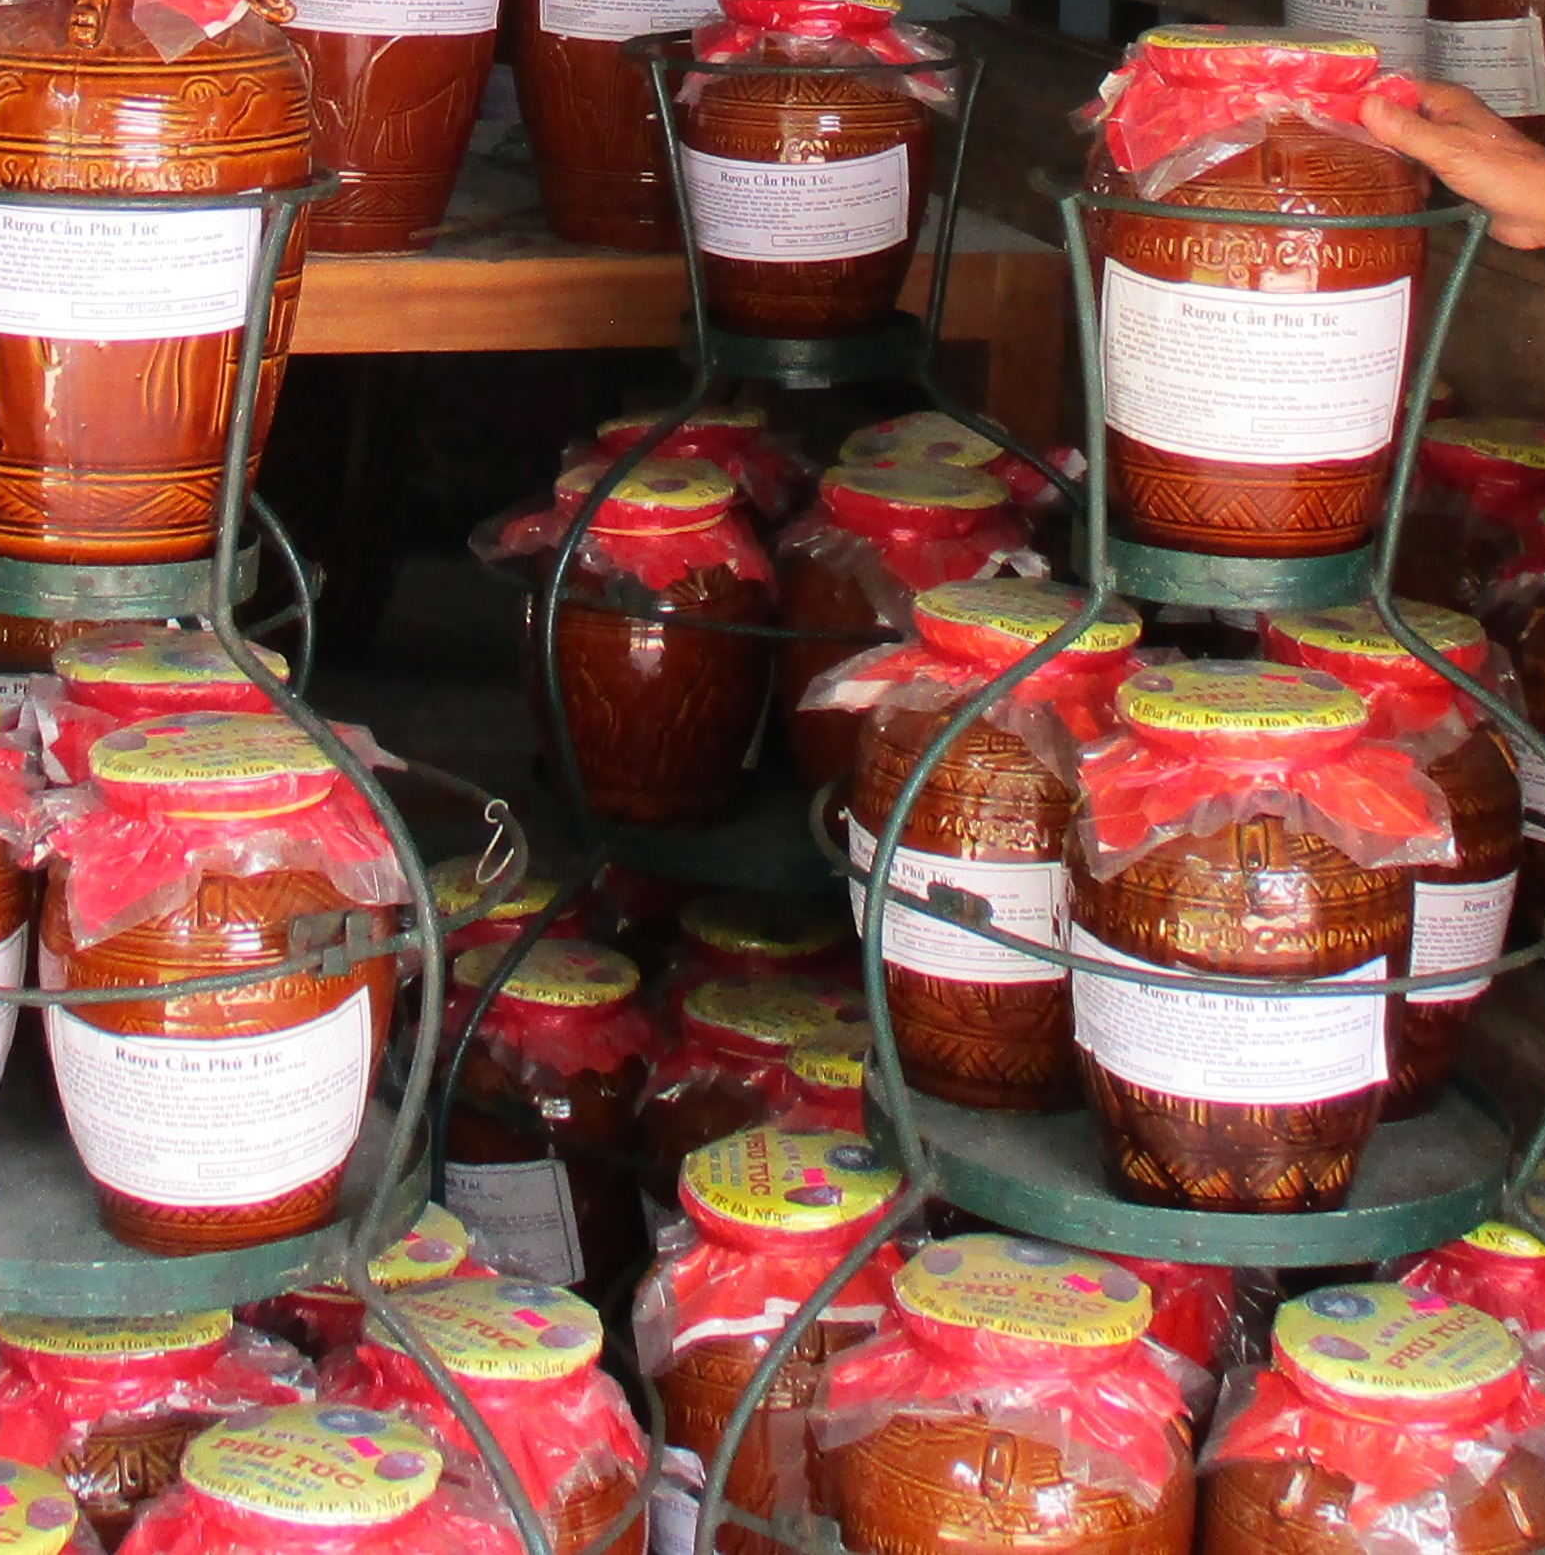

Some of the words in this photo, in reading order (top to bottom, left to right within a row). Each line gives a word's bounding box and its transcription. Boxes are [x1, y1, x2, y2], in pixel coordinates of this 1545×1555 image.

[720, 171, 750, 187] Rượu
[754, 171, 777, 187] Cần
[782, 174, 806, 187] Phú
[812, 174, 834, 186] Túc
[2, 215, 44, 236] Rượu
[50, 215, 83, 236] Cần
[90, 221, 122, 237] Phú
[130, 221, 159, 236] Túc
[1181, 303, 1226, 327] Rượu
[1233, 307, 1265, 326] Cần
[1273, 311, 1304, 328] Phú
[1310, 310, 1340, 328] Túc
[1204, 712, 1254, 729] huyện
[1258, 716, 1291, 728] Hòa
[902, 861, 926, 880] Phú
[1139, 982, 1180, 1006] Rượu
[1185, 991, 1217, 1010] Cần
[1224, 996, 1256, 1013] Phú
[1261, 997, 1293, 1013] Túc
[114, 1046, 159, 1071] Rượu
[165, 1051, 201, 1073] Cần
[208, 1055, 242, 1072] Phú
[250, 1050, 284, 1070] Túc
[710, 1191, 728, 1208] TP.
[730, 1202, 749, 1217] Đà
[752, 1208, 792, 1224] Nẵng
[1001, 1319, 1033, 1337] Hòa
[1039, 1328, 1084, 1345] Vang,
[476, 1358, 500, 1372] TP.
[507, 1361, 525, 1374] Đà
[1372, 1374, 1406, 1388] Hòa
[1410, 1376, 1450, 1391] Phú,
[317, 1499, 341, 1514] TP.
[349, 1500, 372, 1515] Đà
[376, 1491, 413, 1513] Nẵng
